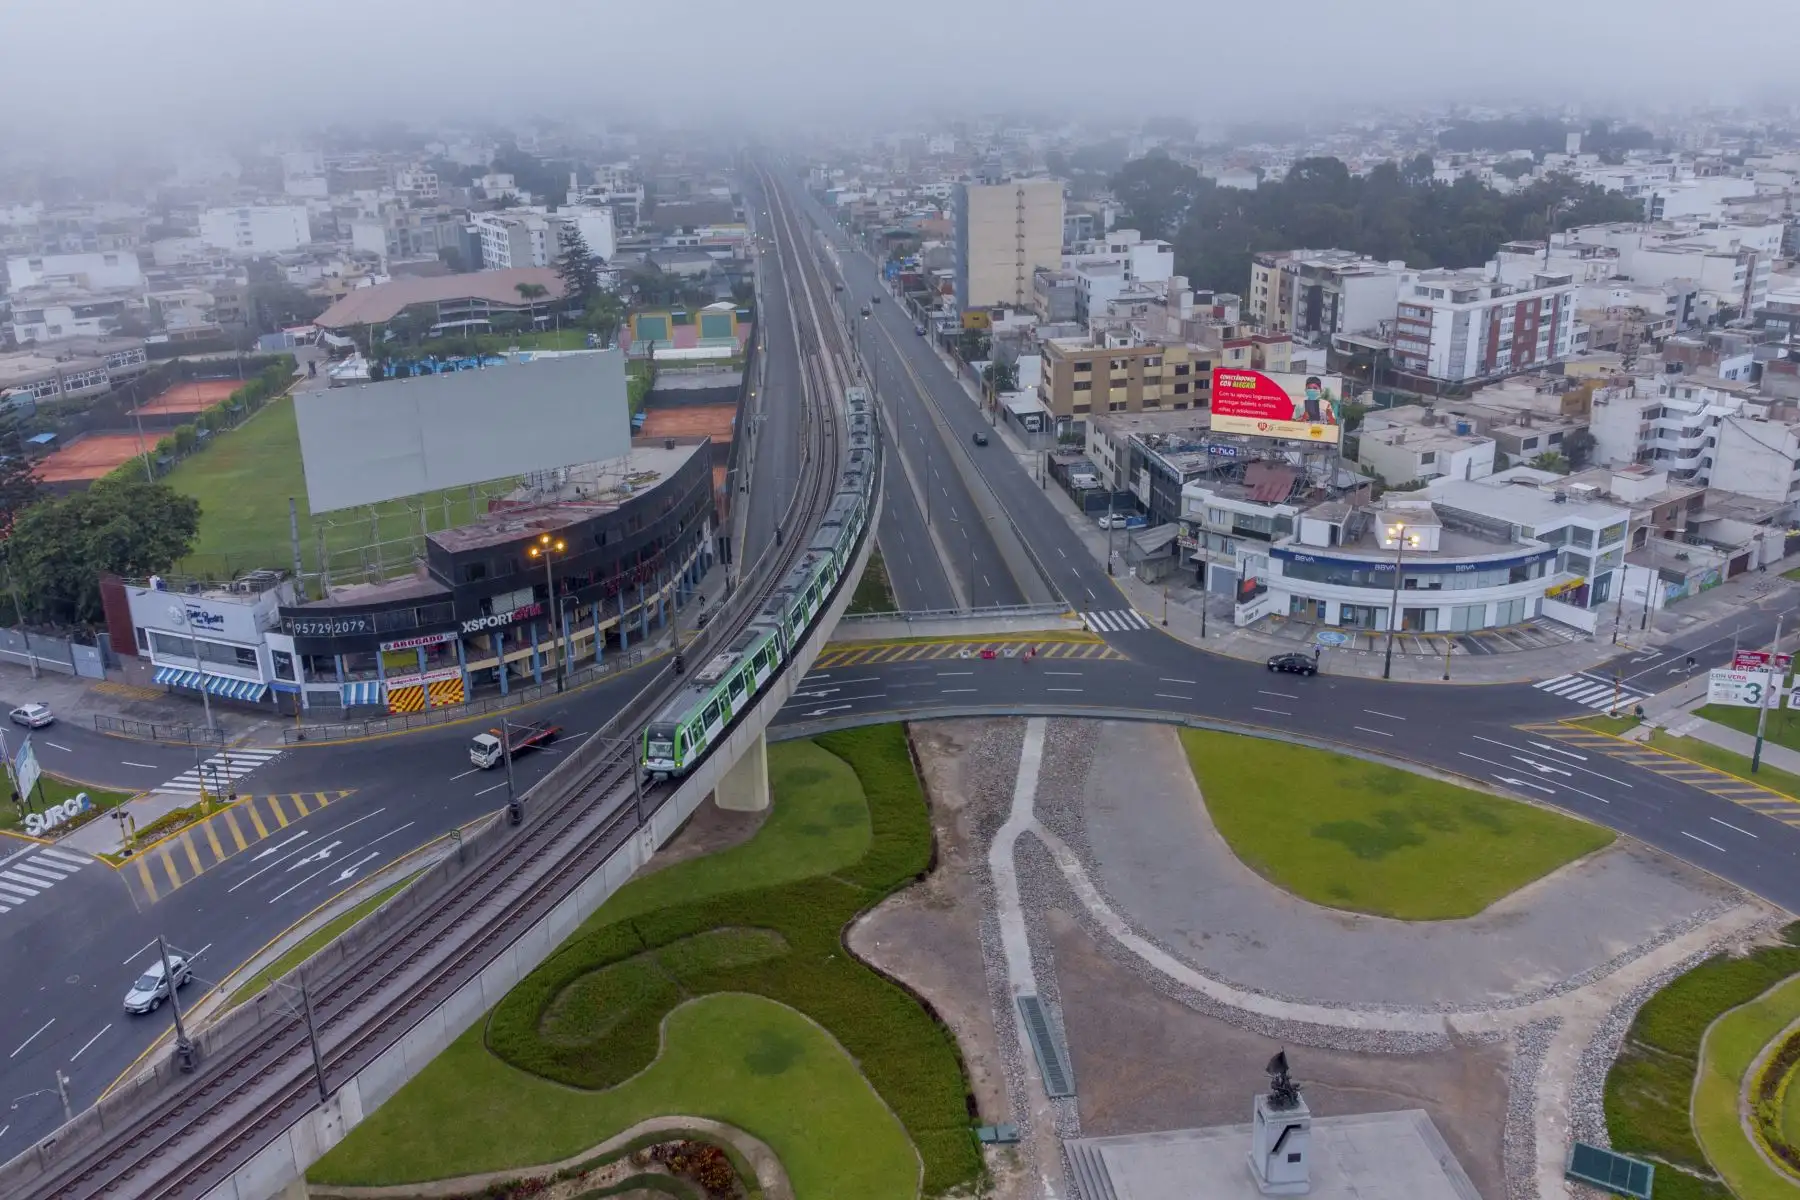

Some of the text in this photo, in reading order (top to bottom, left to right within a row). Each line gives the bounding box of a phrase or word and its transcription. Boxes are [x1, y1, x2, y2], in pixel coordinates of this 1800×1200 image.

[1295, 554, 1315, 563] BBVA
[1455, 564, 1475, 572] BBVA
[393, 636, 443, 648] ABOGADO
[1743, 683, 1762, 705] 3
[25, 792, 90, 836] SURCO
